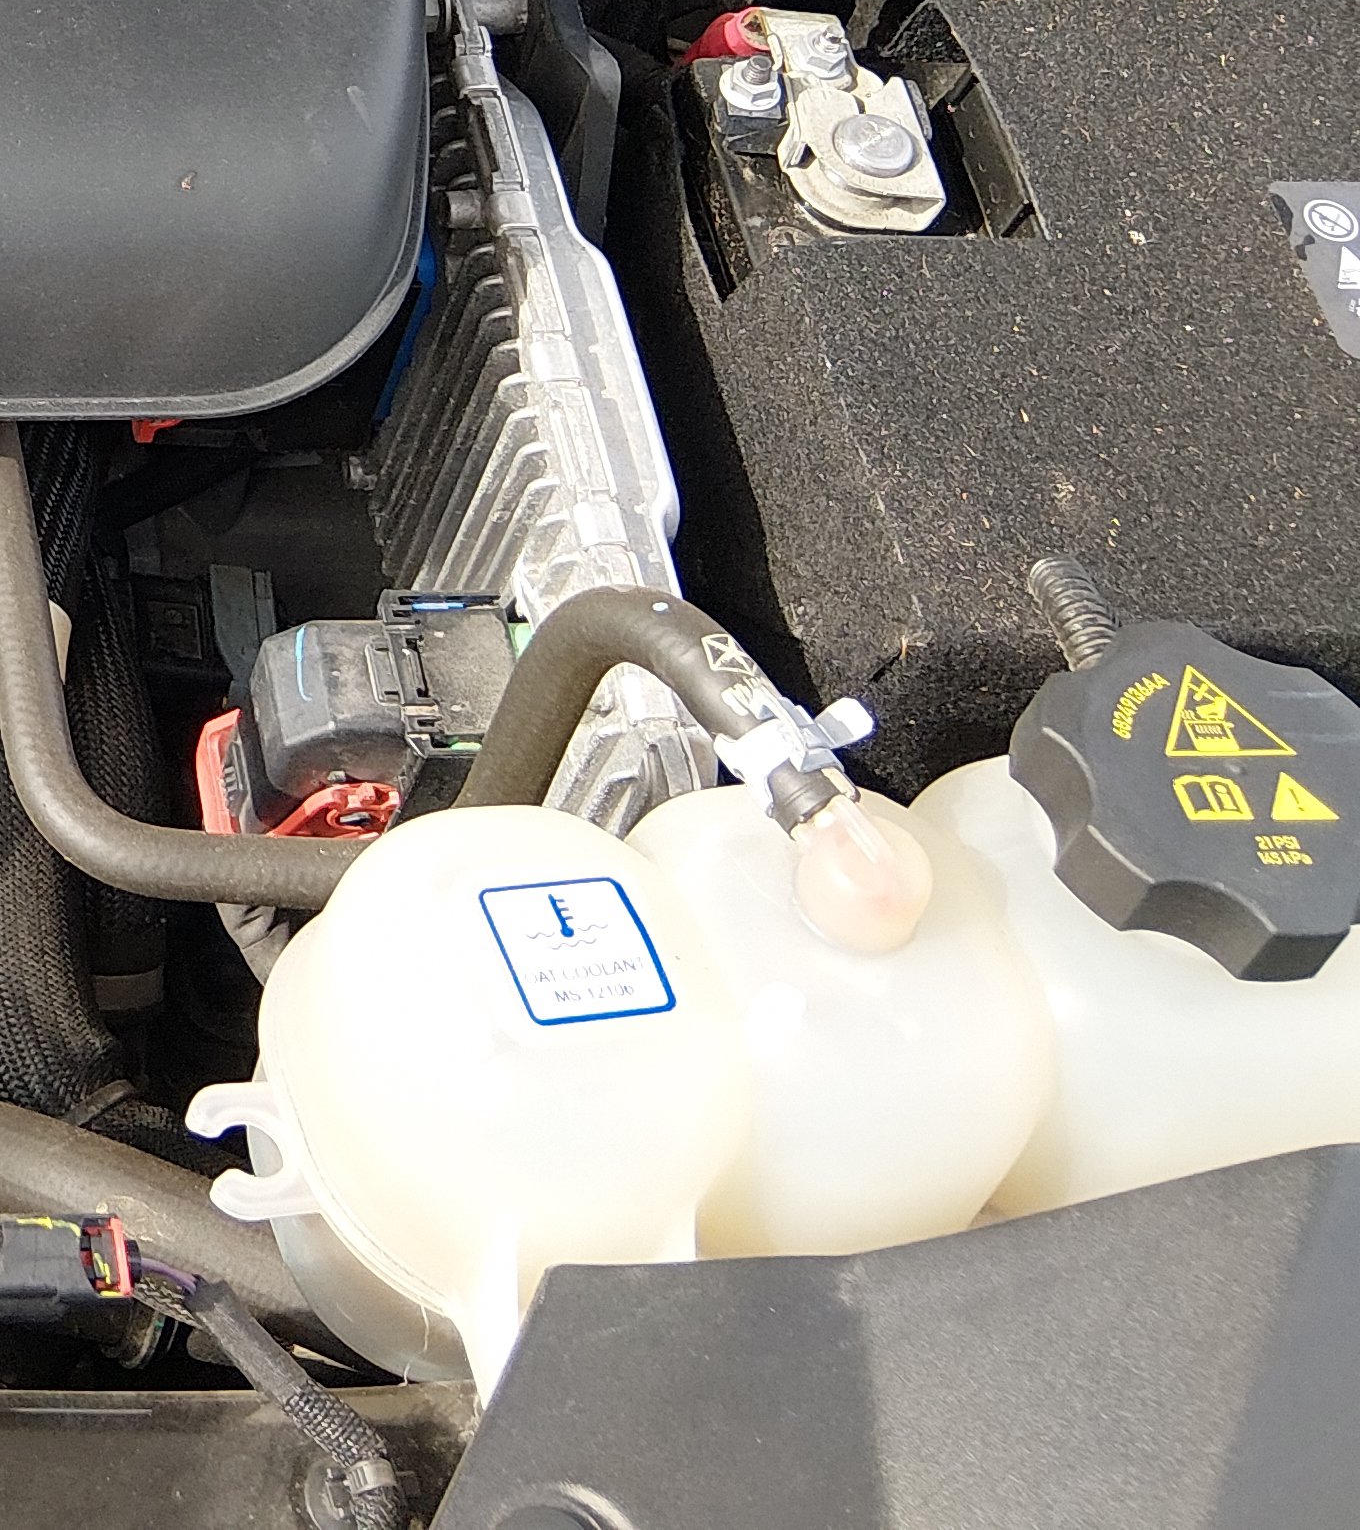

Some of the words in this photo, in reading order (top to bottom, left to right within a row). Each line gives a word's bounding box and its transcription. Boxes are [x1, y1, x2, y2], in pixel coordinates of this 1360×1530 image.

[1271, 835, 1301, 850] PSI
[563, 956, 645, 981] COOLANT
[554, 989, 582, 1003] MS
